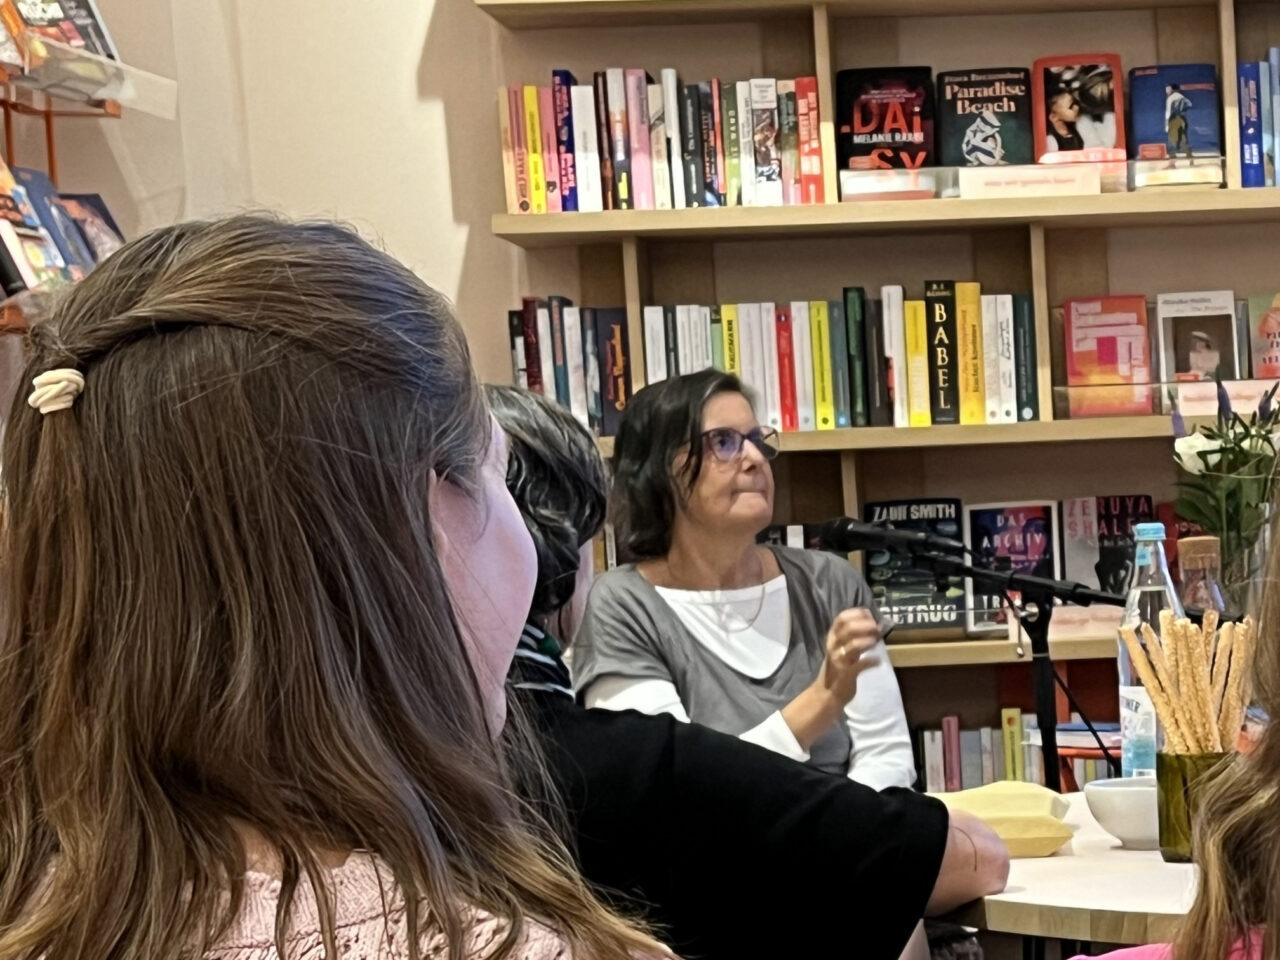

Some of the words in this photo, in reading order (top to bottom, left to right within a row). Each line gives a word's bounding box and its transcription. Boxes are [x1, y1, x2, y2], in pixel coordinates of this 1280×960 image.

[945, 81, 1026, 100] Paradise
[957, 97, 1016, 115] Beach
[934, 303, 951, 409] BABEL
[910, 503, 956, 520] SMITH
[1067, 496, 1149, 517] ZERUYA
[996, 513, 1027, 528] DAS
[982, 533, 1042, 550] ARCHIV
